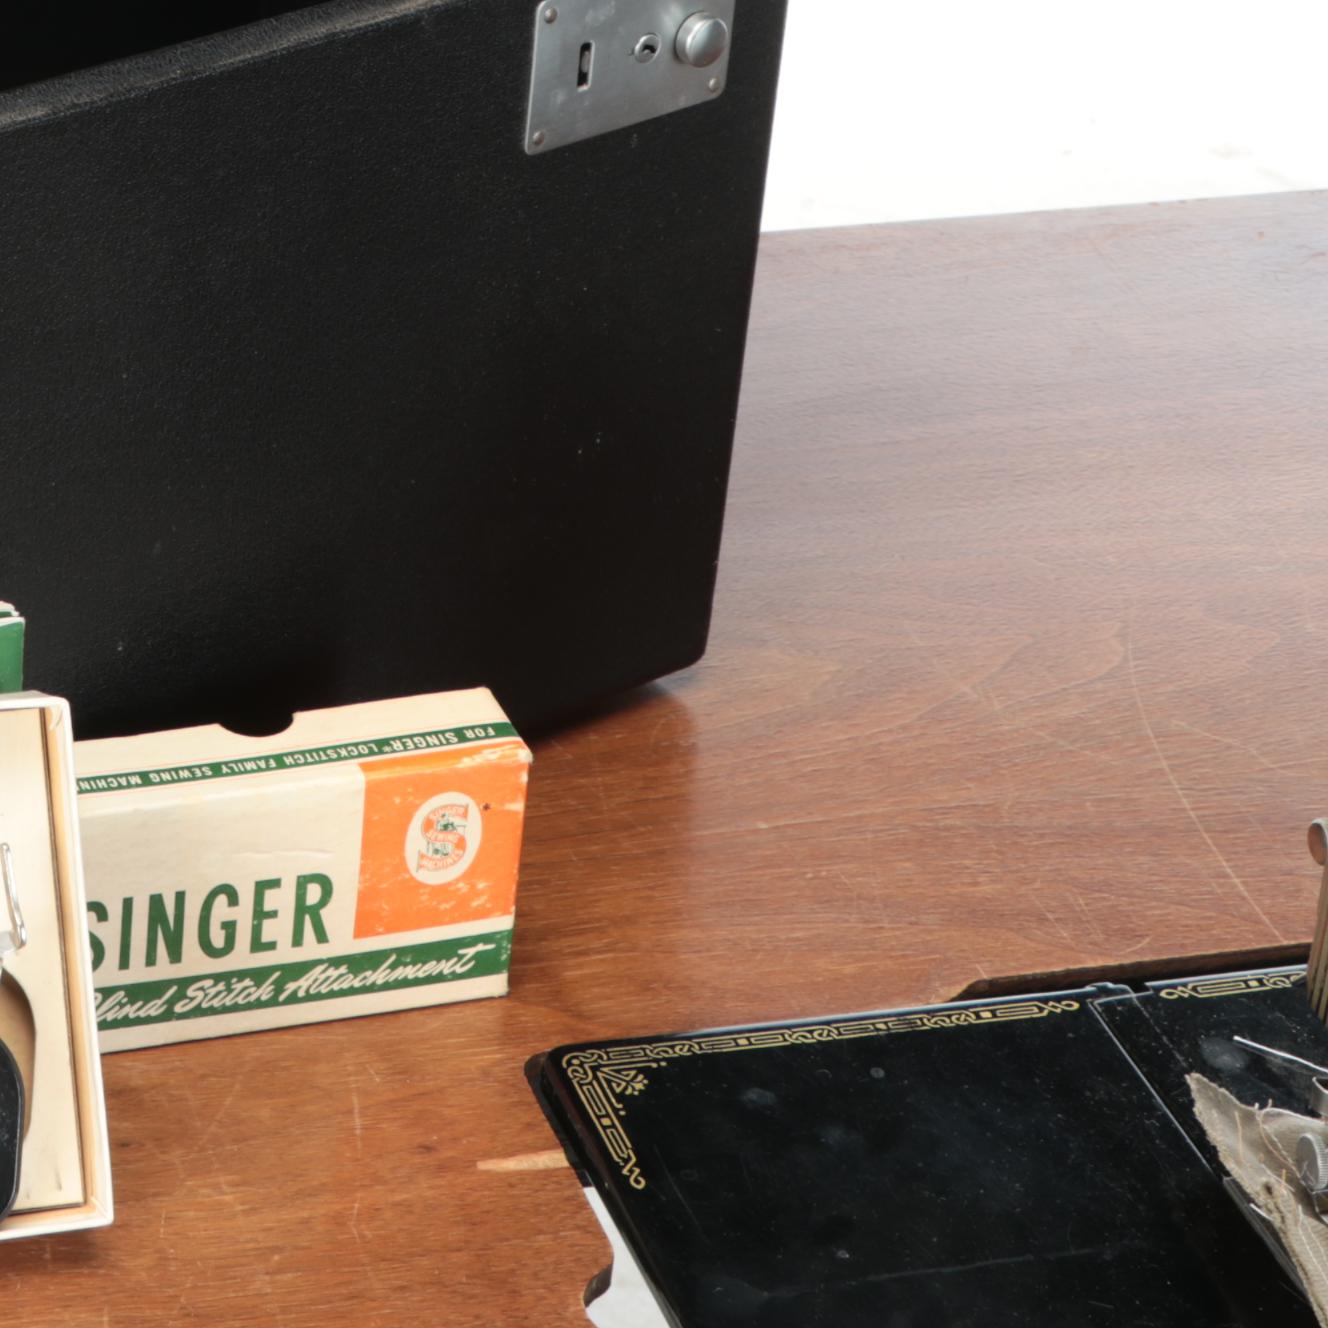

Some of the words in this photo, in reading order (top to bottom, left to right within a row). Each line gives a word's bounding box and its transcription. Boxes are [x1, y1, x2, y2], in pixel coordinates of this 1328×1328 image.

[465, 726, 496, 739] FOR
[283, 743, 379, 766] LOCKSTITCH
[148, 766, 213, 783] SEWING
[221, 757, 277, 775] FAMILY
[76, 774, 143, 792] MACHIN
[86, 872, 334, 973] SINGER
[173, 973, 277, 1015] Stitch
[278, 943, 497, 1003] Attachment
